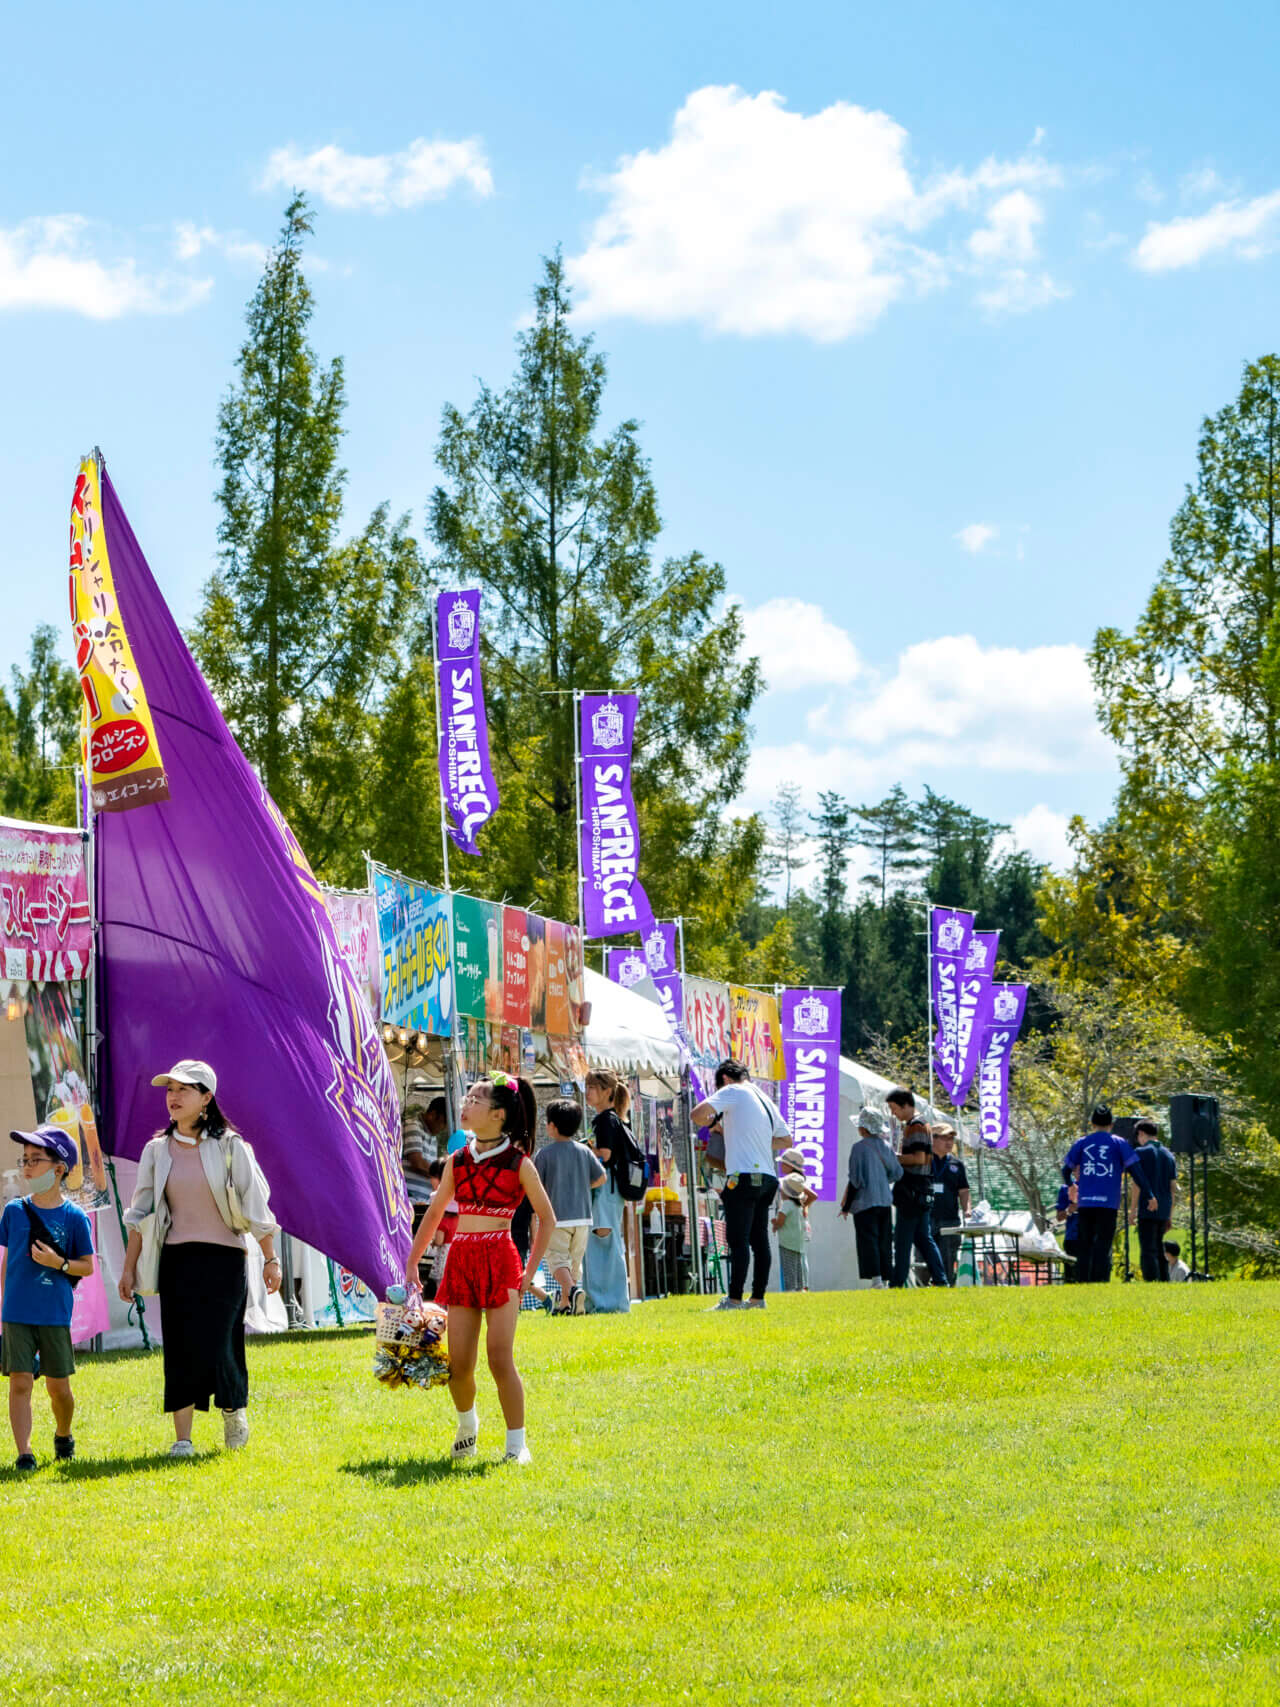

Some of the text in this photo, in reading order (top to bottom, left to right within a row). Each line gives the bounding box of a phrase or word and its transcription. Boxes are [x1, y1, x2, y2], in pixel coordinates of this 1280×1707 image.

[91, 725, 137, 750] ヘルシー
[451, 667, 493, 843] SANFRECC
[590, 807, 601, 872] HIROSHIMA
[594, 764, 638, 924] SANFRECCE
